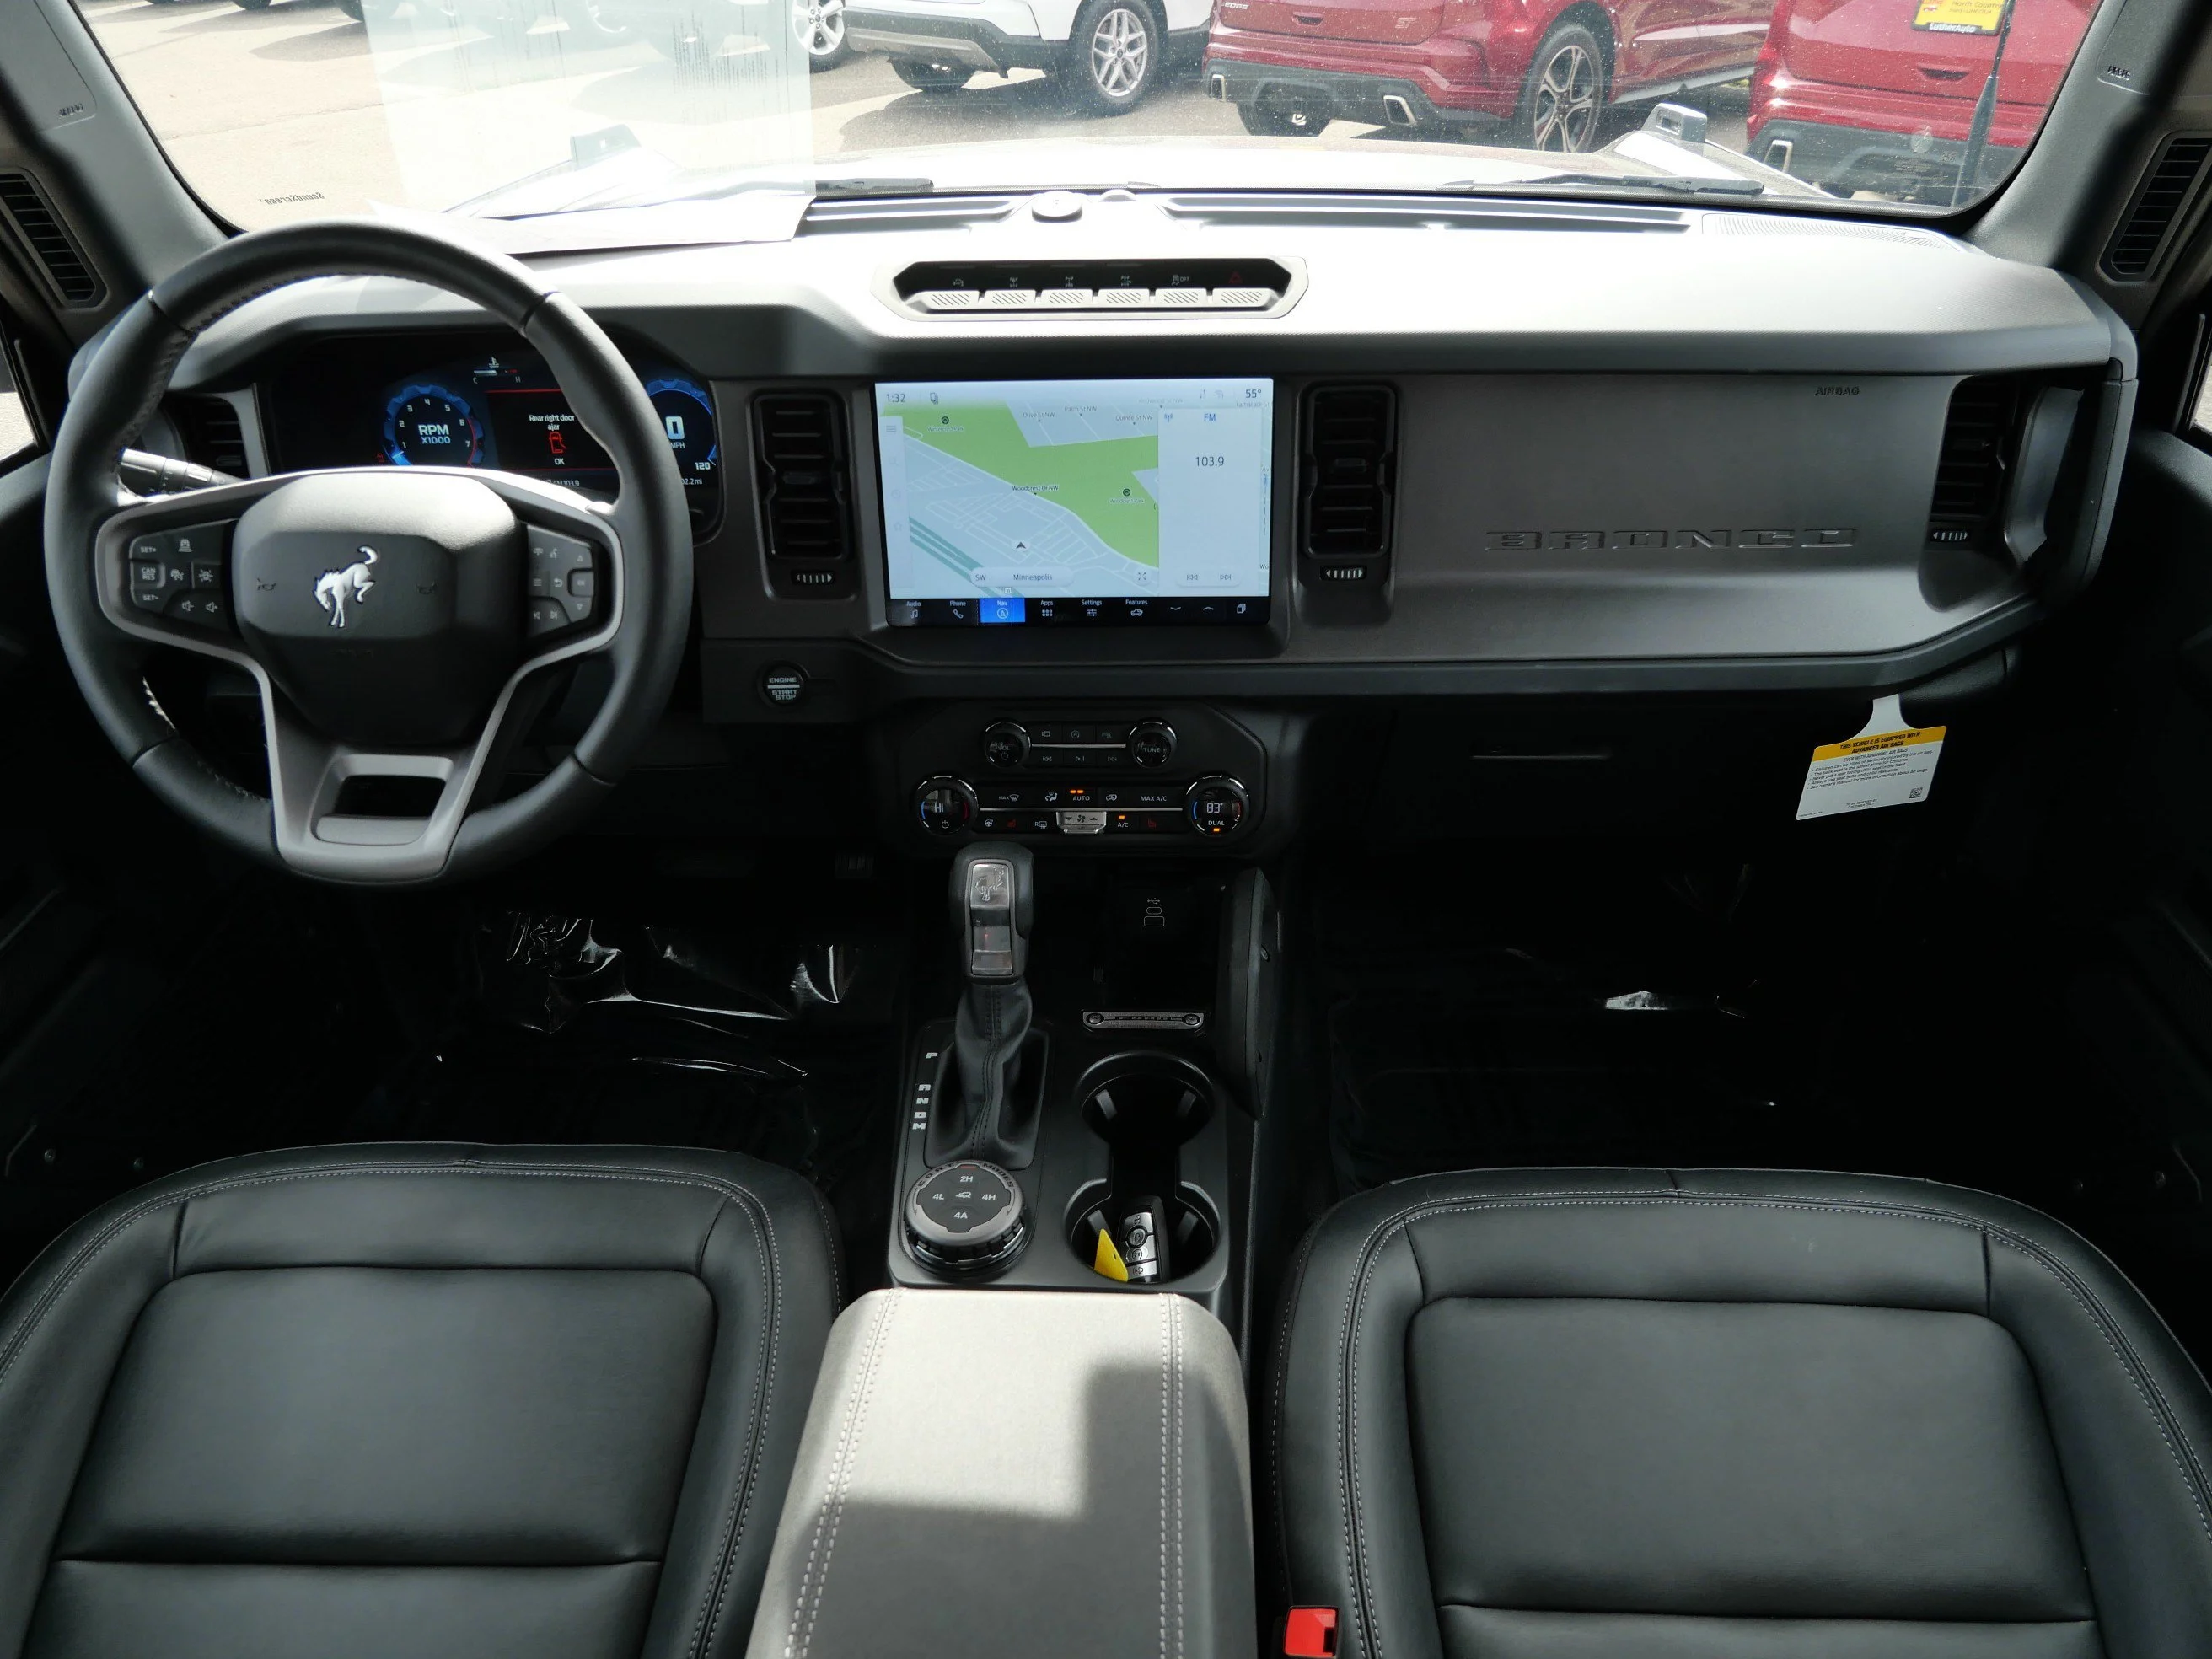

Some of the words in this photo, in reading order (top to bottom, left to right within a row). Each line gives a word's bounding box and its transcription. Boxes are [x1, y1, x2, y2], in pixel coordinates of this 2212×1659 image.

[1225, 2, 1249, 10] EDGE
[1396, 16, 1416, 30] ST
[1245, 389, 1262, 399] 55°
[1815, 385, 1860, 396] AIRBAG
[886, 393, 906, 403] 1:32
[529, 414, 544, 422] Rear
[544, 414, 560, 423] right
[1204, 413, 1216, 421] FM
[417, 423, 450, 436] RPM
[547, 423, 560, 432] ajar
[665, 416, 685, 440] 0
[421, 436, 451, 444] X1000
[670, 441, 685, 449] MPH
[695, 462, 711, 470] 120
[1195, 456, 1225, 467] 103.9
[1485, 528, 1858, 551] BRONCO
[1012, 572, 1053, 583] Minneapolis
[1040, 599, 1054, 608] Apps
[1081, 599, 1103, 607] Settings
[1880, 733, 1905, 742] EQUIPPED
[1851, 744, 1879, 753] ADVANCED
[934, 803, 944, 813] HI
[981, 1193, 996, 1201] 4H
